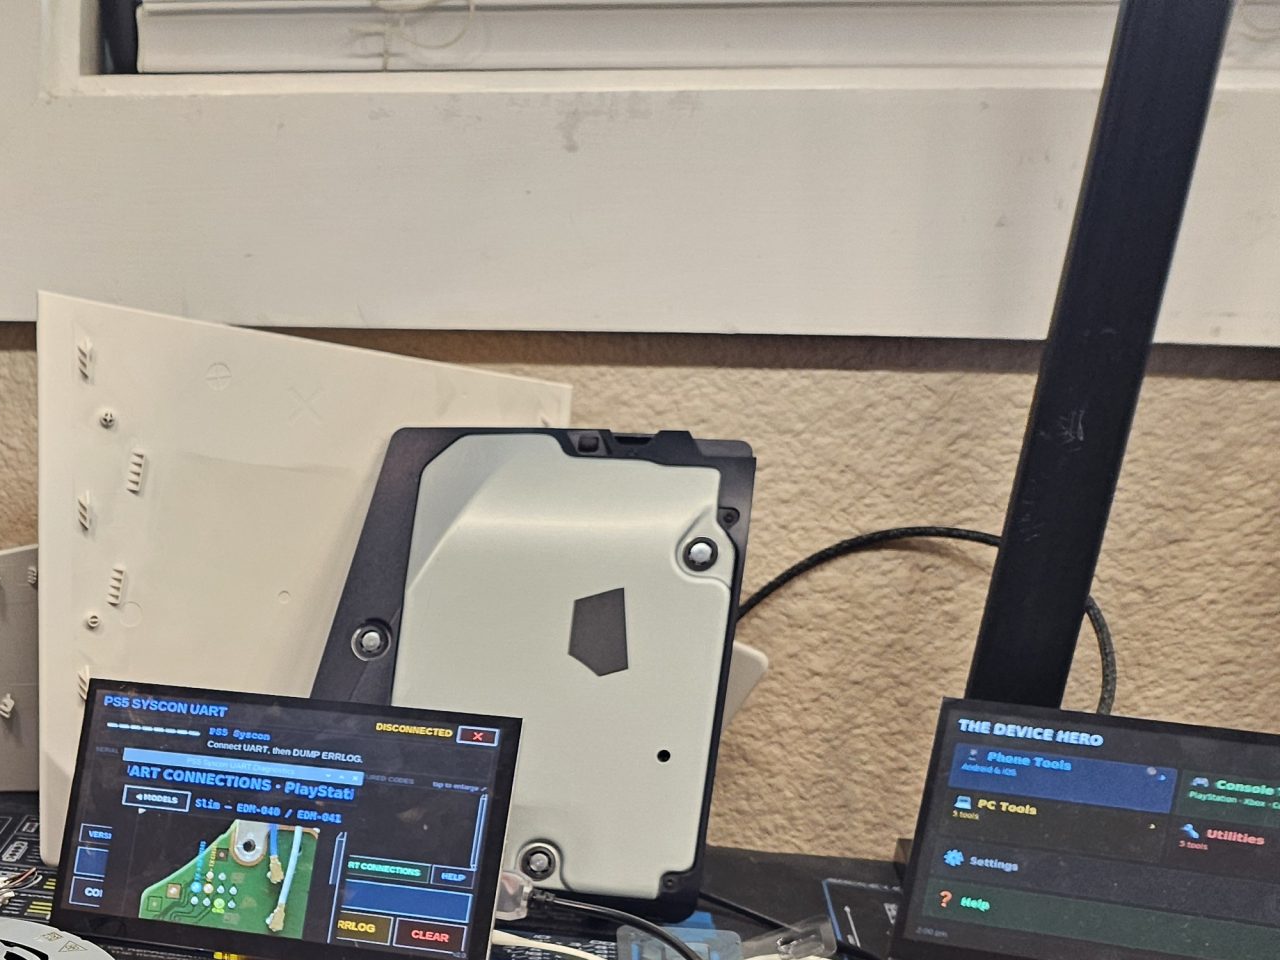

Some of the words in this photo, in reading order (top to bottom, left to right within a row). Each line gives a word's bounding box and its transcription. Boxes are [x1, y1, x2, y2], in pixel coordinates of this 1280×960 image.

[103, 695, 130, 708] PS5
[131, 697, 188, 714] SYSCON
[189, 704, 228, 718] UART
[208, 727, 228, 737] PS5
[233, 729, 271, 741] Syscon
[375, 722, 454, 738] DISCONNECTED
[958, 718, 991, 734] THE
[993, 722, 1054, 741] DEVICE
[1056, 730, 1104, 747] HERO
[207, 740, 242, 751] Connect
[272, 747, 292, 757] then
[293, 748, 321, 759] DUMP
[961, 762, 994, 774] Android
[987, 751, 1031, 766] Phone
[1033, 757, 1072, 771] Tools
[163, 769, 272, 792] CONNECTIONS
[1215, 780, 1275, 796] Console
[143, 791, 178, 805] MODELS
[195, 798, 220, 810] Slim
[1189, 790, 1238, 803] PlayStation
[1243, 798, 1265, 807] Xbox
[977, 799, 997, 810] PC
[999, 801, 1038, 815] Tools
[1207, 829, 1265, 845] Utilities
[1187, 842, 1209, 851] tools
[361, 862, 422, 878] CONNECTIONS
[969, 856, 1019, 872] Settings
[440, 872, 466, 882] HELP
[960, 896, 991, 912] Help
[411, 930, 450, 943] CLEAR
